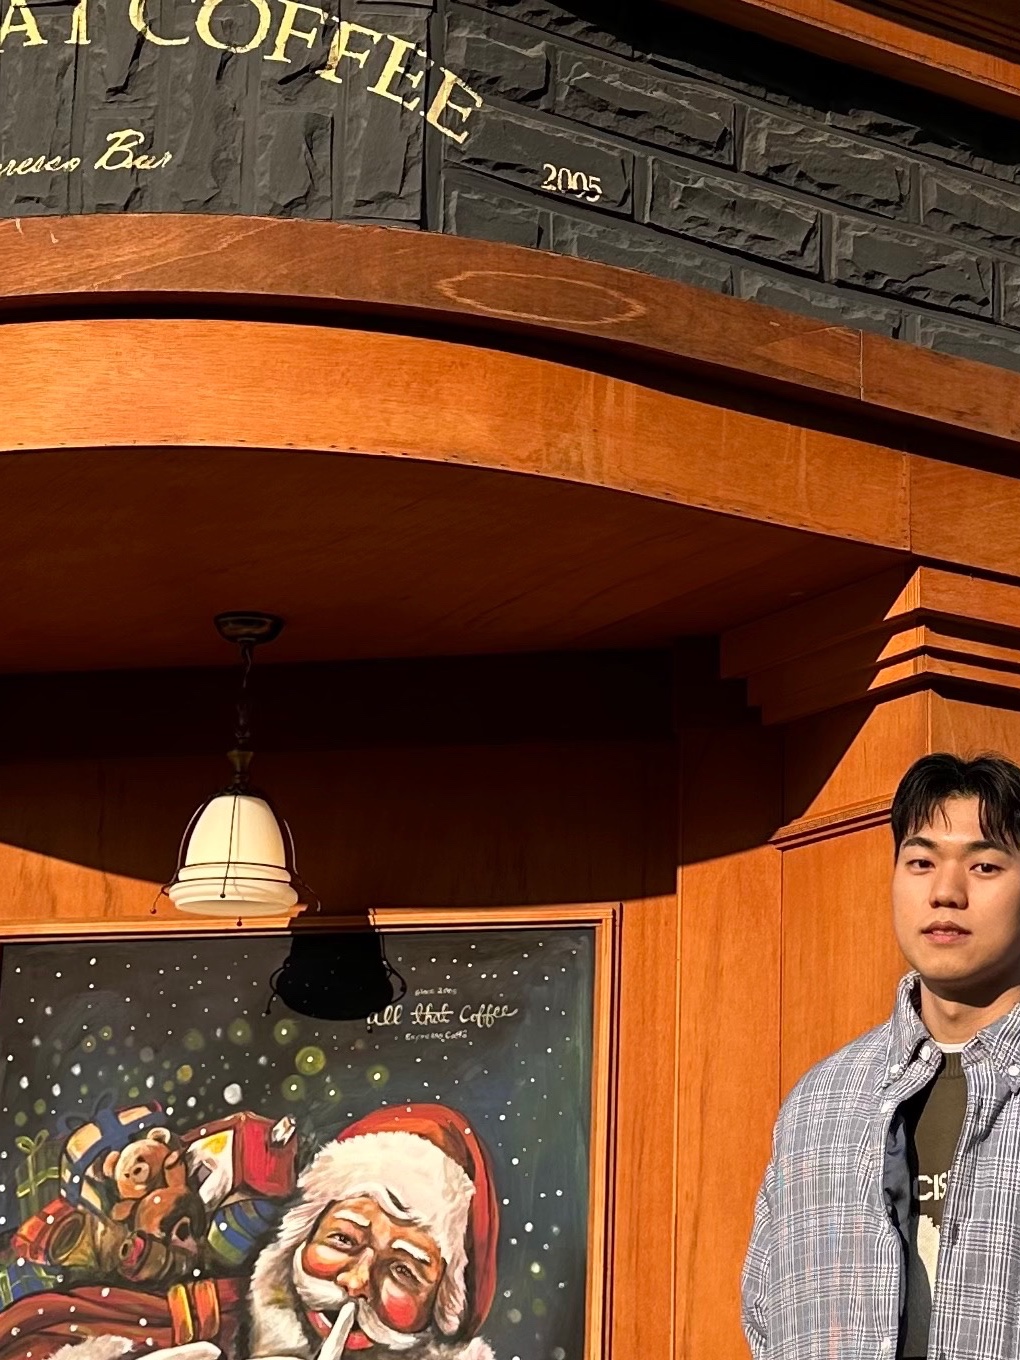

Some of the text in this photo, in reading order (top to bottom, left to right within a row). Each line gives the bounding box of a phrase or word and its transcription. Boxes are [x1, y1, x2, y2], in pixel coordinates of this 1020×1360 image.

[128, 0, 483, 144] COFFEE
[540, 163, 603, 203] 2005
[410, 1002, 455, 1026] that
[459, 1003, 518, 1028] Coffee
